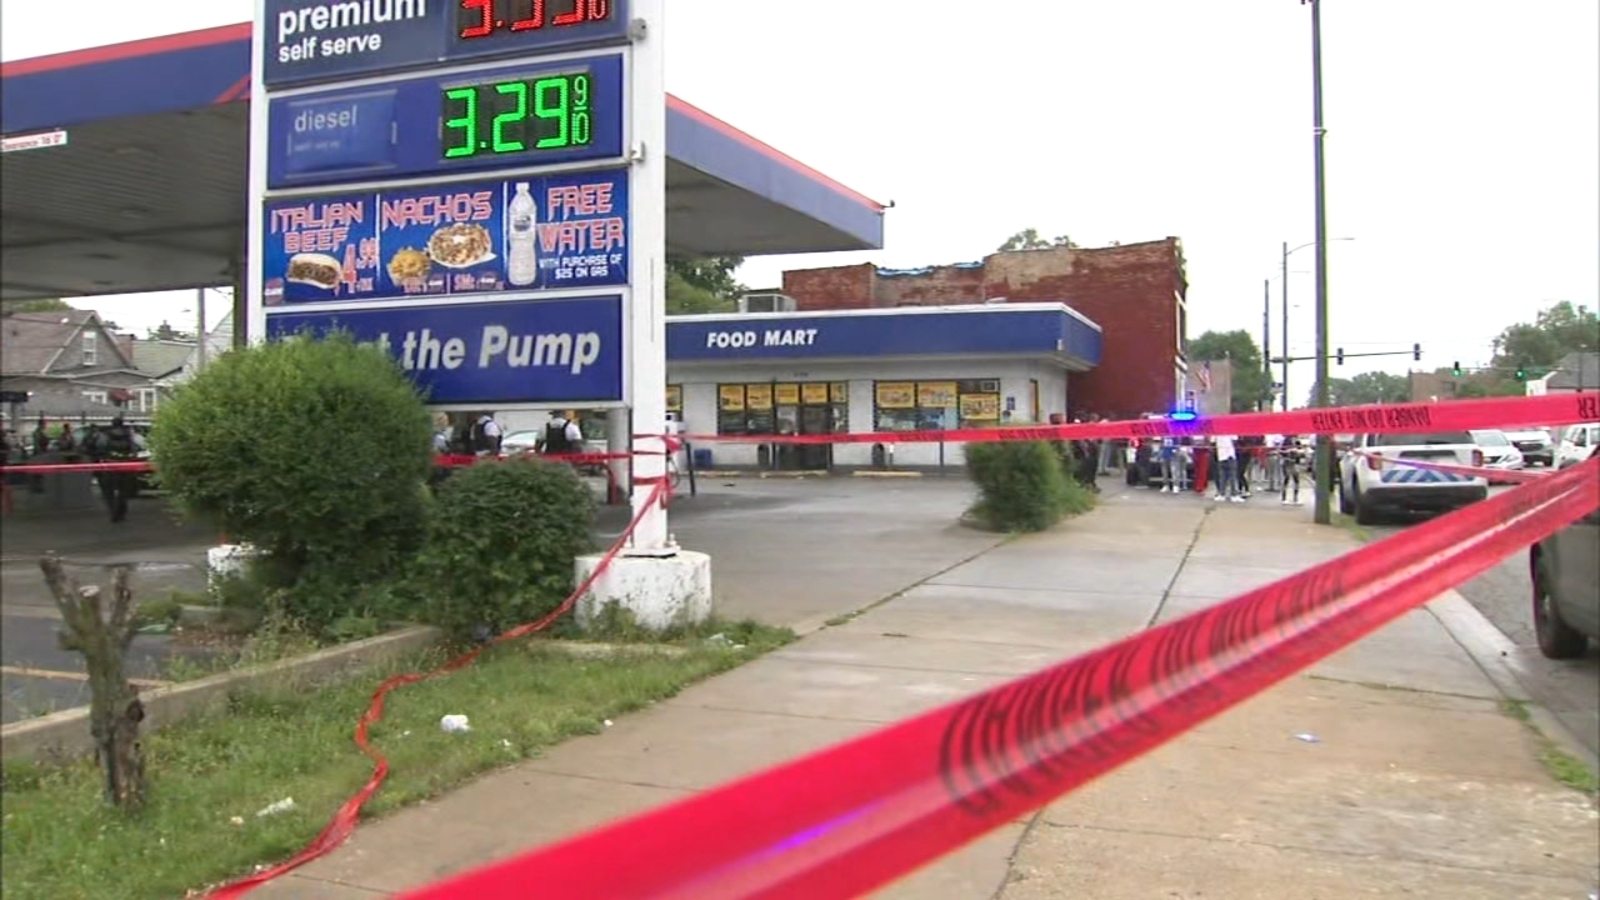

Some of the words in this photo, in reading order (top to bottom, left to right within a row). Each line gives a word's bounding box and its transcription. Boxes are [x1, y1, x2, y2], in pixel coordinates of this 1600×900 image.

[279, 0, 426, 44] premium
[279, 37, 317, 62] self
[321, 33, 381, 56] serve
[294, 104, 358, 132] diesel
[445, 78, 568, 157] 3.29
[382, 191, 493, 232] NACHOS
[547, 183, 613, 221] FREE
[270, 203, 364, 234] ITALIAN
[284, 226, 350, 253] BEEF
[536, 217, 625, 255] WATER
[555, 268, 573, 279] $25
[575, 267, 588, 278] ON
[590, 266, 608, 276] GAS
[562, 255, 608, 269] PURCHASE
[610, 253, 622, 264] OF
[403, 328, 466, 370] the
[478, 325, 600, 374] Pump
[706, 331, 757, 348] FOOD
[764, 329, 818, 346] MART
